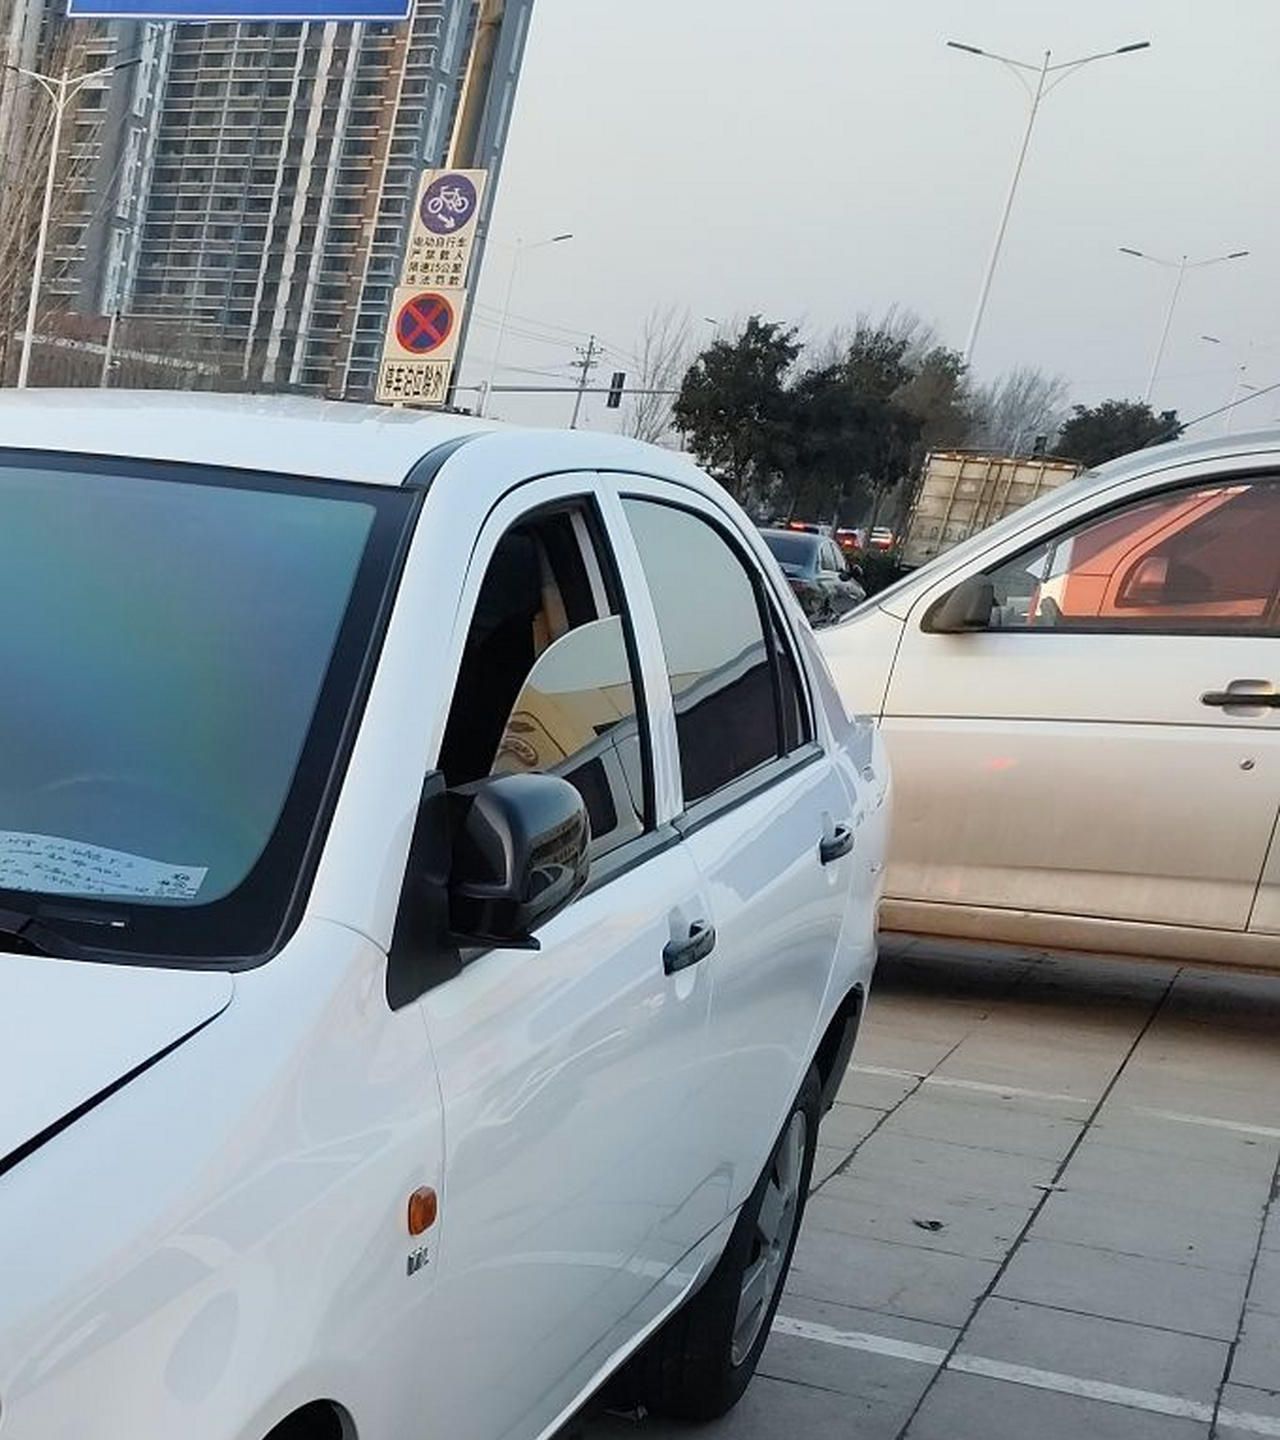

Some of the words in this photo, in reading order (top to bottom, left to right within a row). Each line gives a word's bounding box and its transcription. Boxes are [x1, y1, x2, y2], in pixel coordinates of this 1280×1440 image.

[413, 236, 467, 248] 电动自行车
[409, 249, 464, 261] 严禁载人
[384, 364, 444, 399] 停车泊位除外
